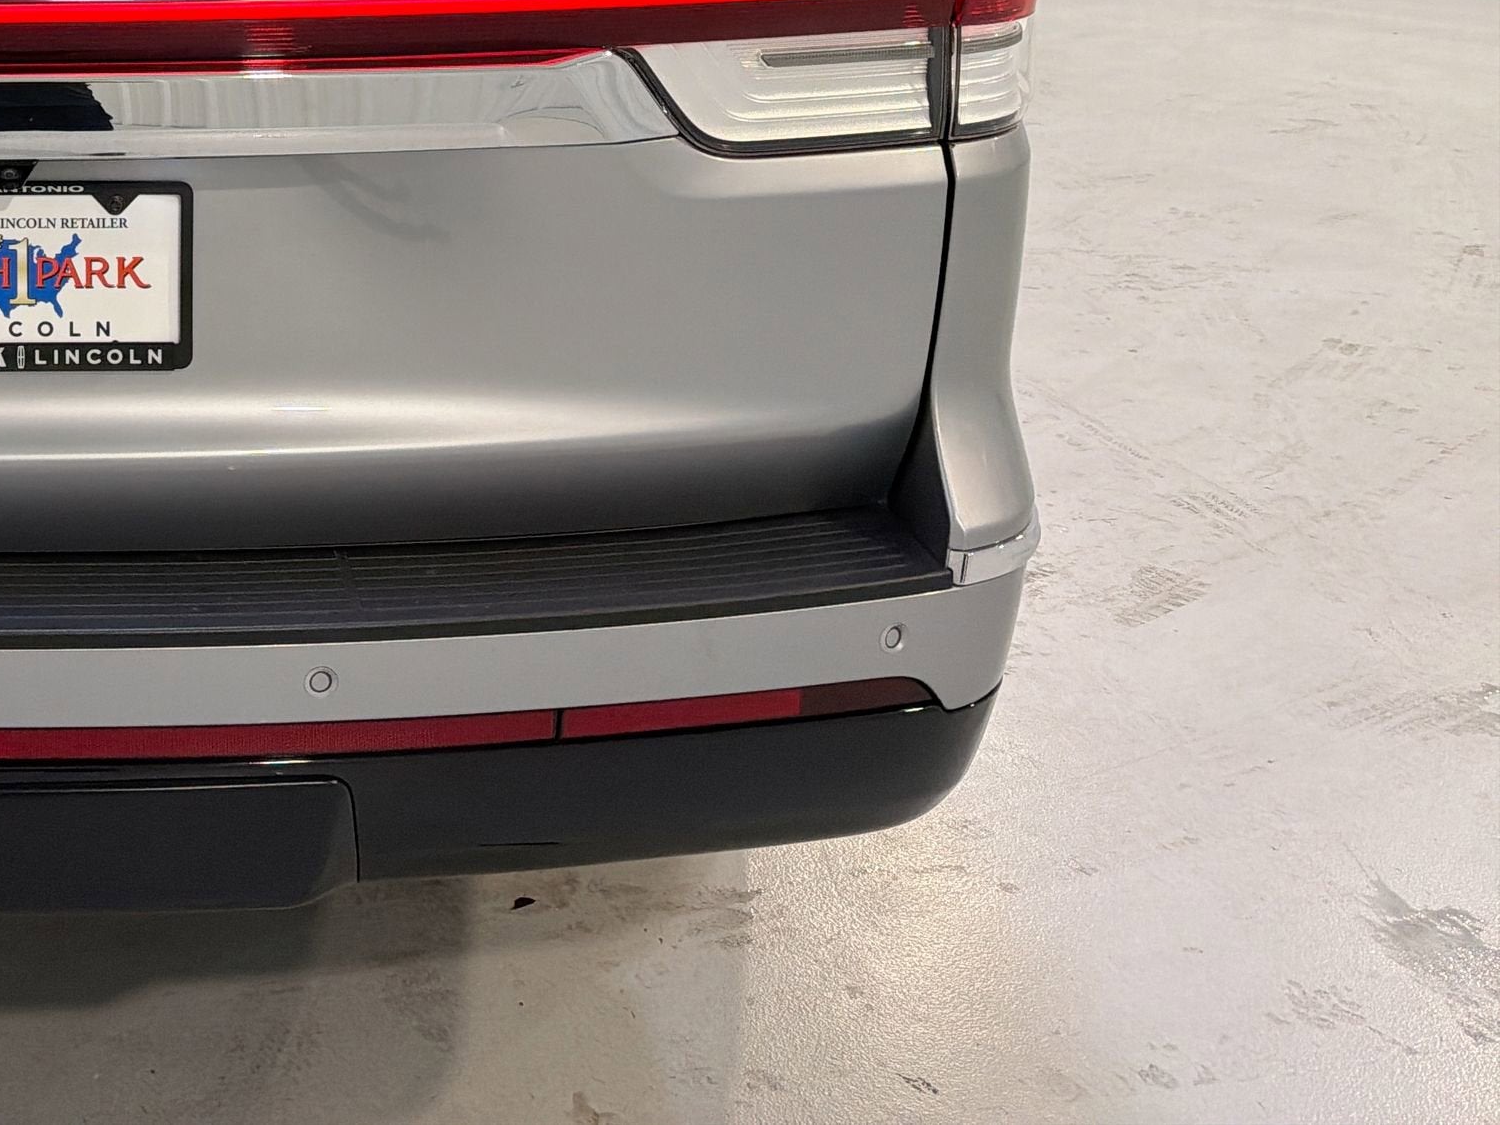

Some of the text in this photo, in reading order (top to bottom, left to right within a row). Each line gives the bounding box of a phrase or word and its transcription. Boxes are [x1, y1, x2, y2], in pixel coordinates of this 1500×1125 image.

[60, 217, 129, 229] RETAILER
[35, 256, 152, 290] PARK
[34, 349, 163, 365] LINCOLN
